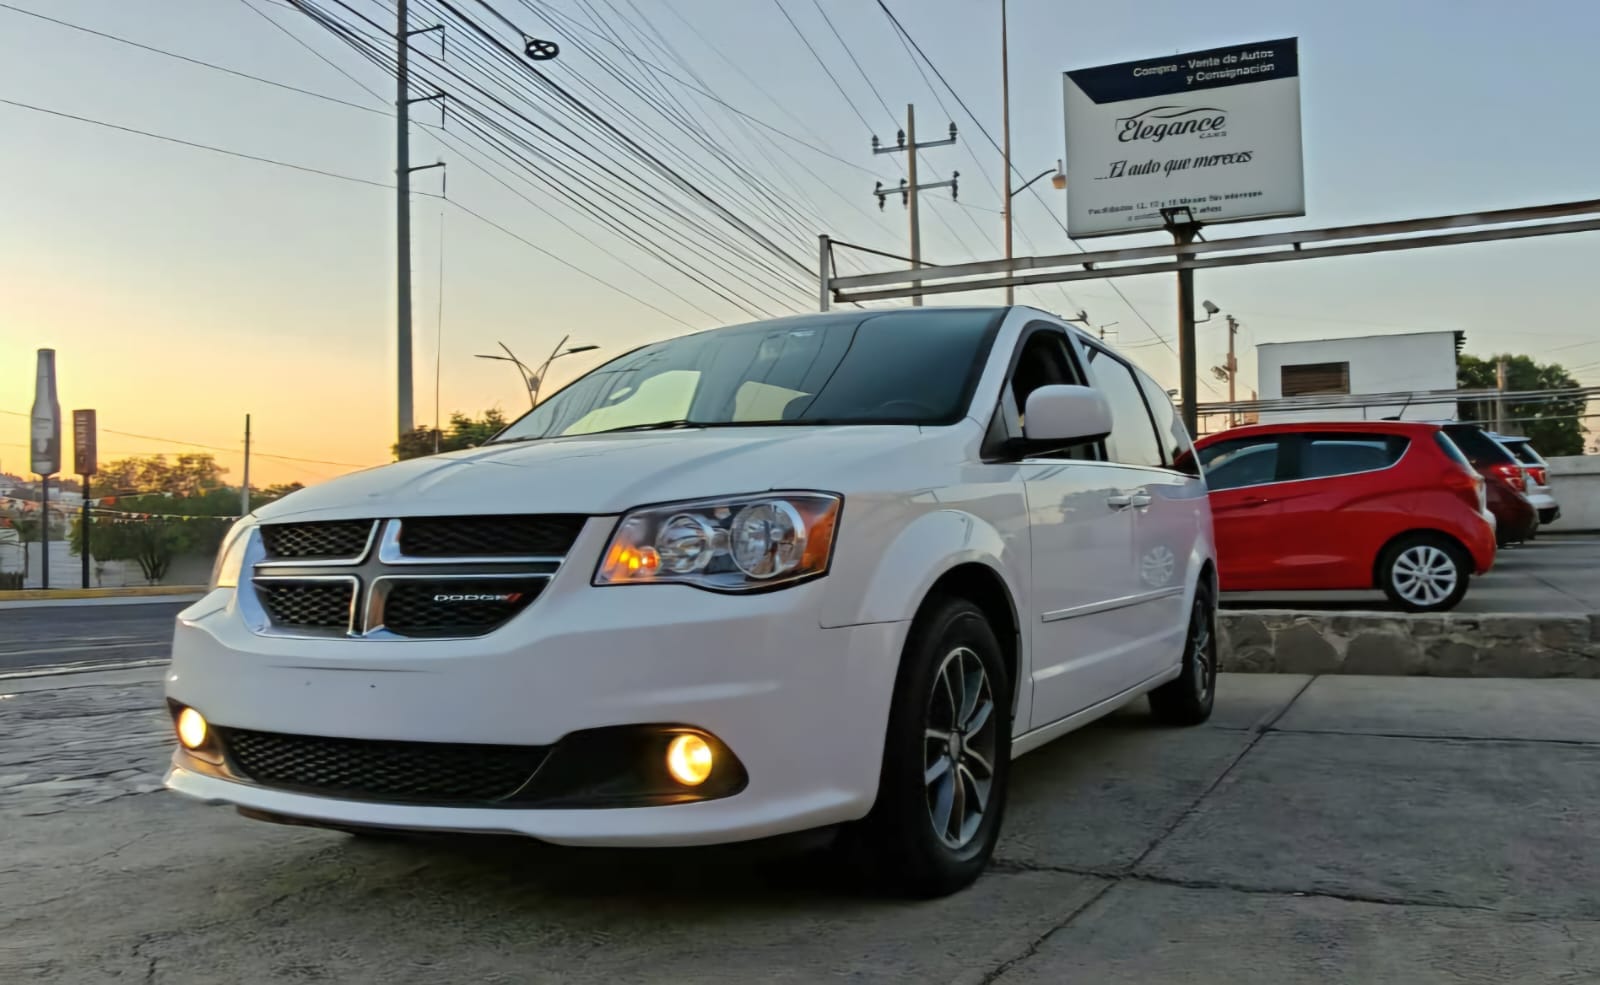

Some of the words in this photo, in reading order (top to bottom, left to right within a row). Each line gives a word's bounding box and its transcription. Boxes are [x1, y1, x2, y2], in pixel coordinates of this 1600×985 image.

[1133, 64, 1178, 78] Compra
[1187, 57, 1220, 70] Venta
[1222, 54, 1238, 64] de
[1241, 50, 1274, 61] Autos
[1186, 75, 1194, 85] y
[1196, 62, 1275, 82] Consignación
[1117, 115, 1225, 143] Elegance
[1128, 158, 1160, 177] auto
[1164, 158, 1191, 178] que
[1193, 150, 1254, 168] mereces
[434, 594, 508, 602] DODGE
